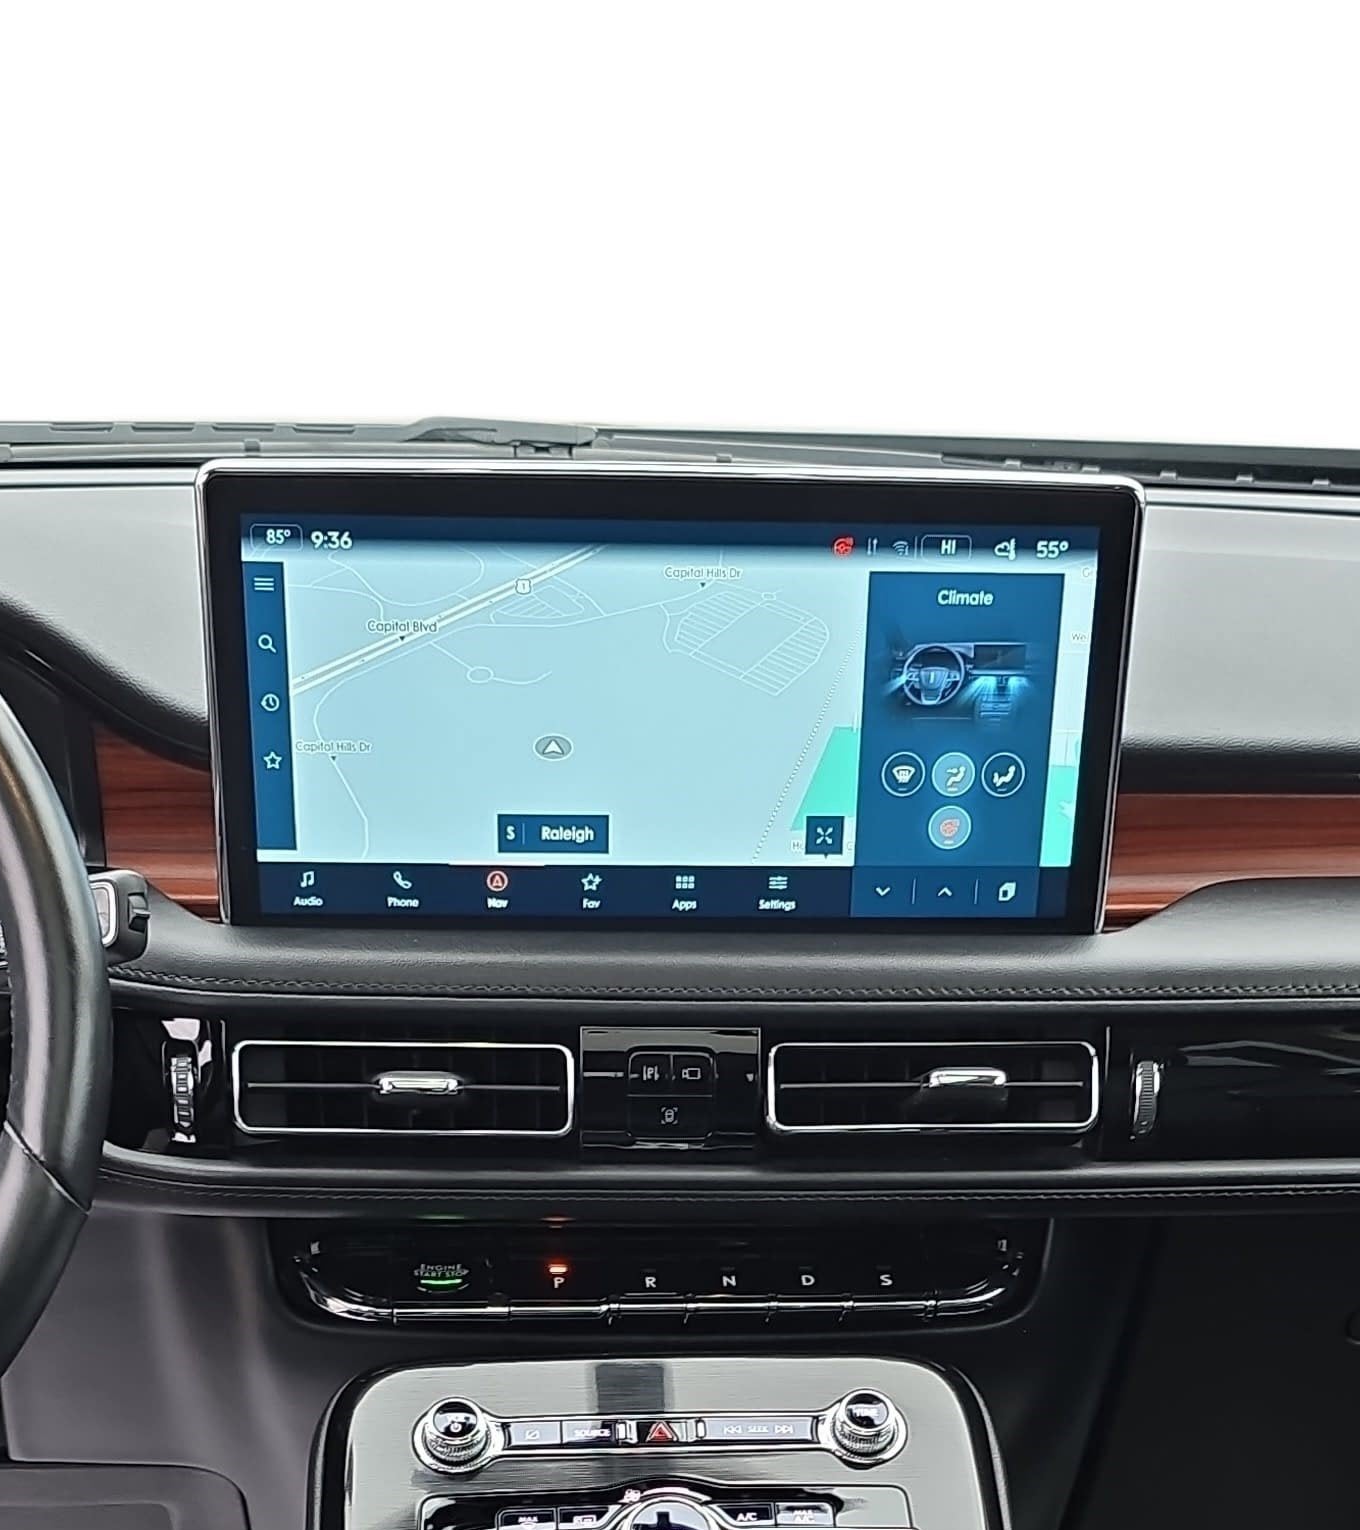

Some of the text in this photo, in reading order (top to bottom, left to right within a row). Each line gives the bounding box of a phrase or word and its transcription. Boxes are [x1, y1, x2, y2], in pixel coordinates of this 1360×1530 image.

[310, 530, 353, 549] 9:36
[940, 539, 957, 555] HI
[665, 566, 741, 580] Capital Hills Dr
[937, 590, 994, 606] Climate
[367, 620, 438, 635] Capital Blvd
[295, 741, 372, 752] Capital Hills Dr
[506, 825, 516, 840] S
[541, 826, 595, 843] Raleigh
[293, 896, 324, 907] Audio
[387, 896, 419, 907] Phone
[487, 897, 509, 908] Nav
[582, 898, 601, 909] Fav
[671, 899, 697, 911] Apps
[758, 899, 796, 912] Settings
[553, 1276, 565, 1288] P
[645, 1276, 657, 1288] R
[722, 1275, 737, 1287] N
[801, 1274, 815, 1286] D
[879, 1274, 893, 1286] S
[736, 1512, 758, 1521] A/C
